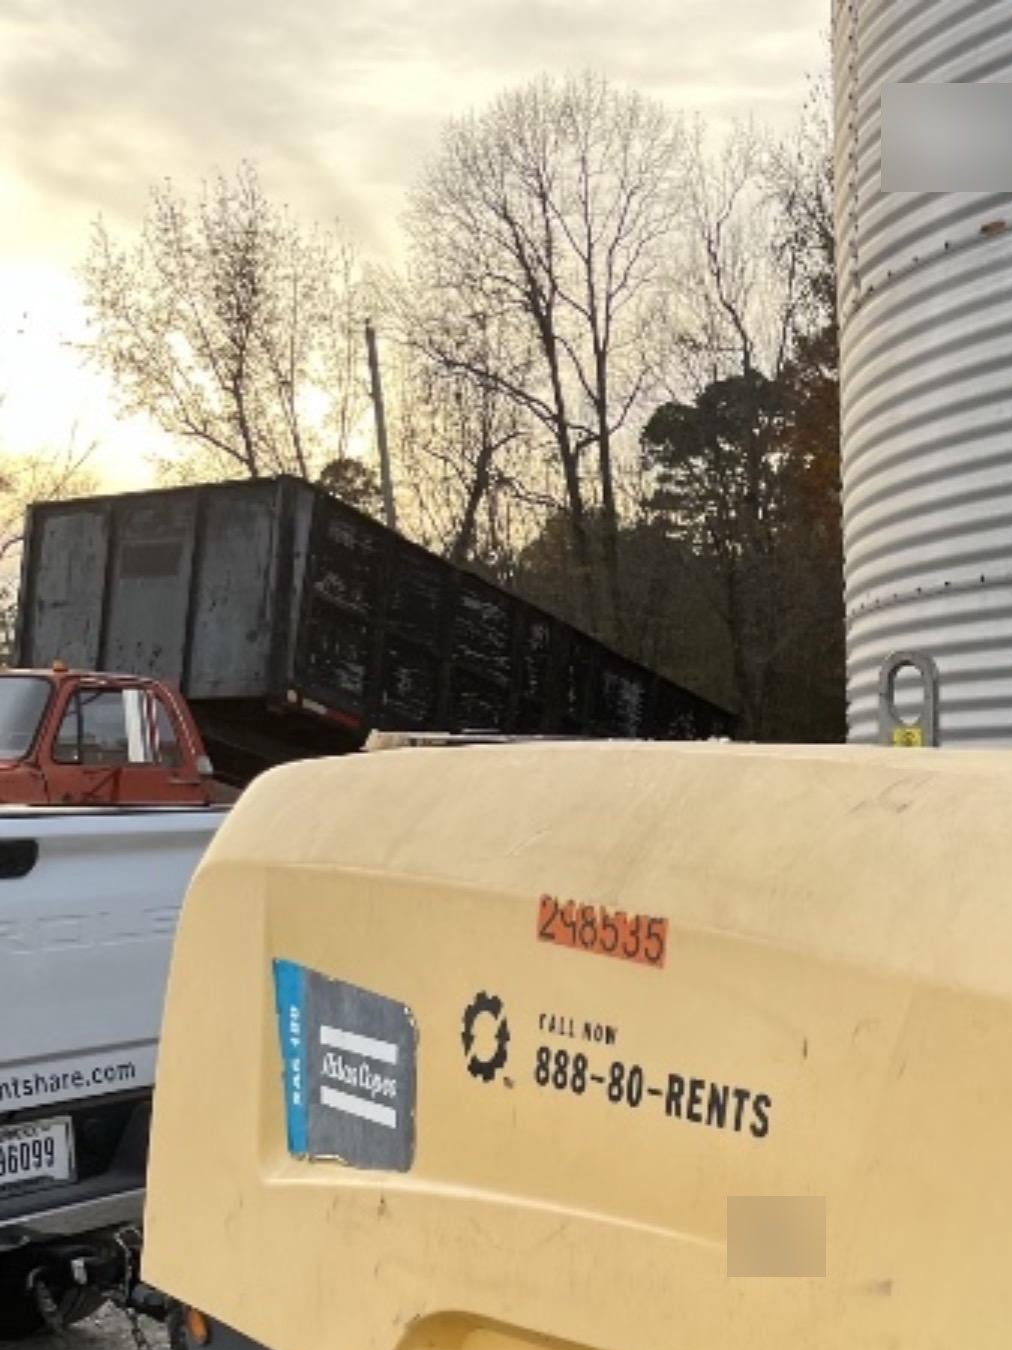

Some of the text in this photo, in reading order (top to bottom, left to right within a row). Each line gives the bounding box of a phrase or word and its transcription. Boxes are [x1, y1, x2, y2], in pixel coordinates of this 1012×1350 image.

[539, 894, 666, 963] 248535
[538, 1012, 618, 1045] CALL NOW
[534, 1045, 772, 1138] 888-80-RENTS
